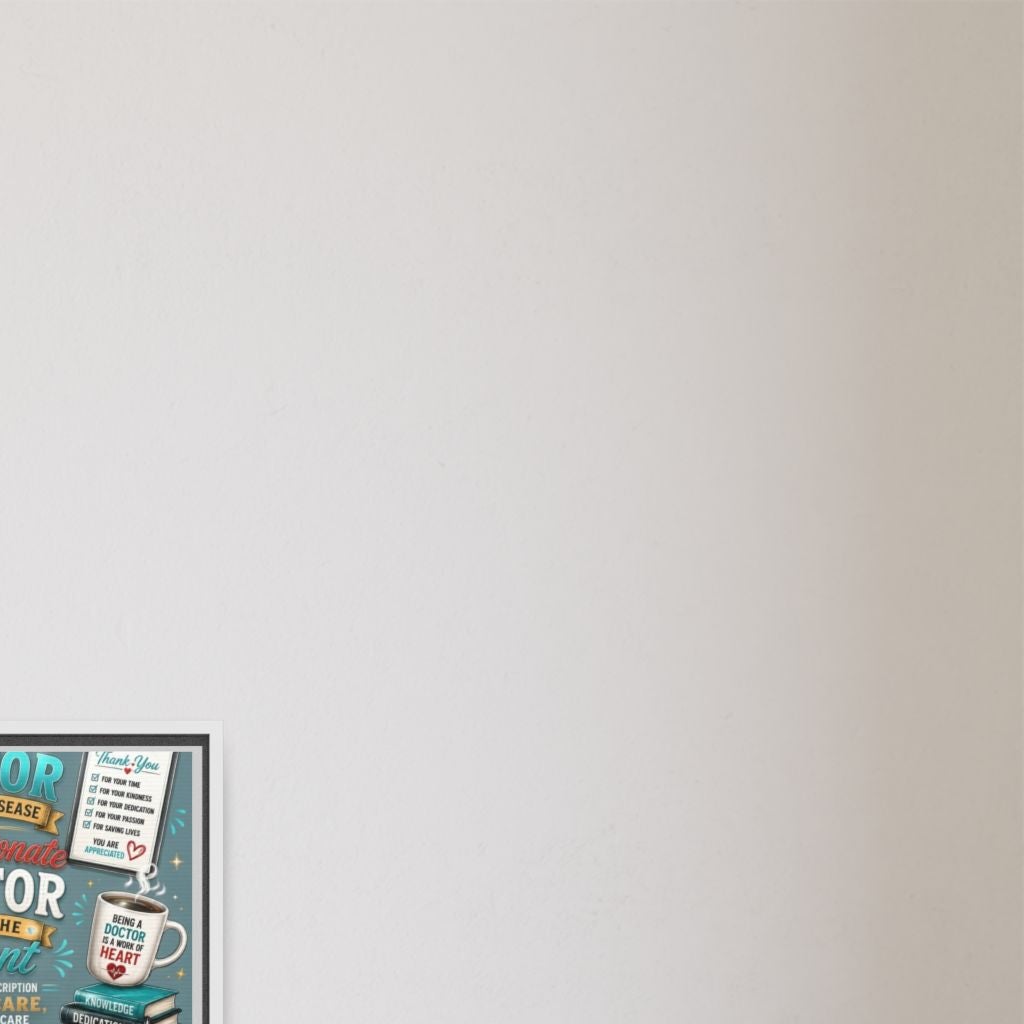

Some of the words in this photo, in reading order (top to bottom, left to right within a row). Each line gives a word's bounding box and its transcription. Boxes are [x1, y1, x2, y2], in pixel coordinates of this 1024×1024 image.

[96, 751, 129, 766] Thank
[133, 755, 160, 774] You
[113, 777, 127, 786] YOUR
[128, 780, 141, 788] TIME
[99, 787, 110, 795] FOR
[111, 789, 125, 797] YOUR
[126, 791, 152, 802] KINDNESS
[97, 799, 108, 807] FOR
[109, 800, 123, 809] YOUR
[124, 803, 155, 814] DEDICATION
[107, 812, 121, 820] YOUR
[122, 815, 145, 825] PASSION
[105, 824, 124, 834] SAVING
[125, 828, 141, 837] LIVES
[93, 838, 105, 847] YOU
[106, 840, 119, 849] ARE
[84, 846, 125, 859] APPRECIATED
[112, 914, 135, 927] BEING
[136, 920, 143, 929] A
[104, 923, 146, 943] DOCTOR
[102, 936, 108, 944] IS
[110, 938, 115, 946] A
[116, 939, 134, 950] WORK
[135, 943, 144, 952] OF
[99, 946, 141, 965] HEART
[85, 996, 135, 1016] KNOWLEDGE
[0, 1015, 29, 1024] CARE
